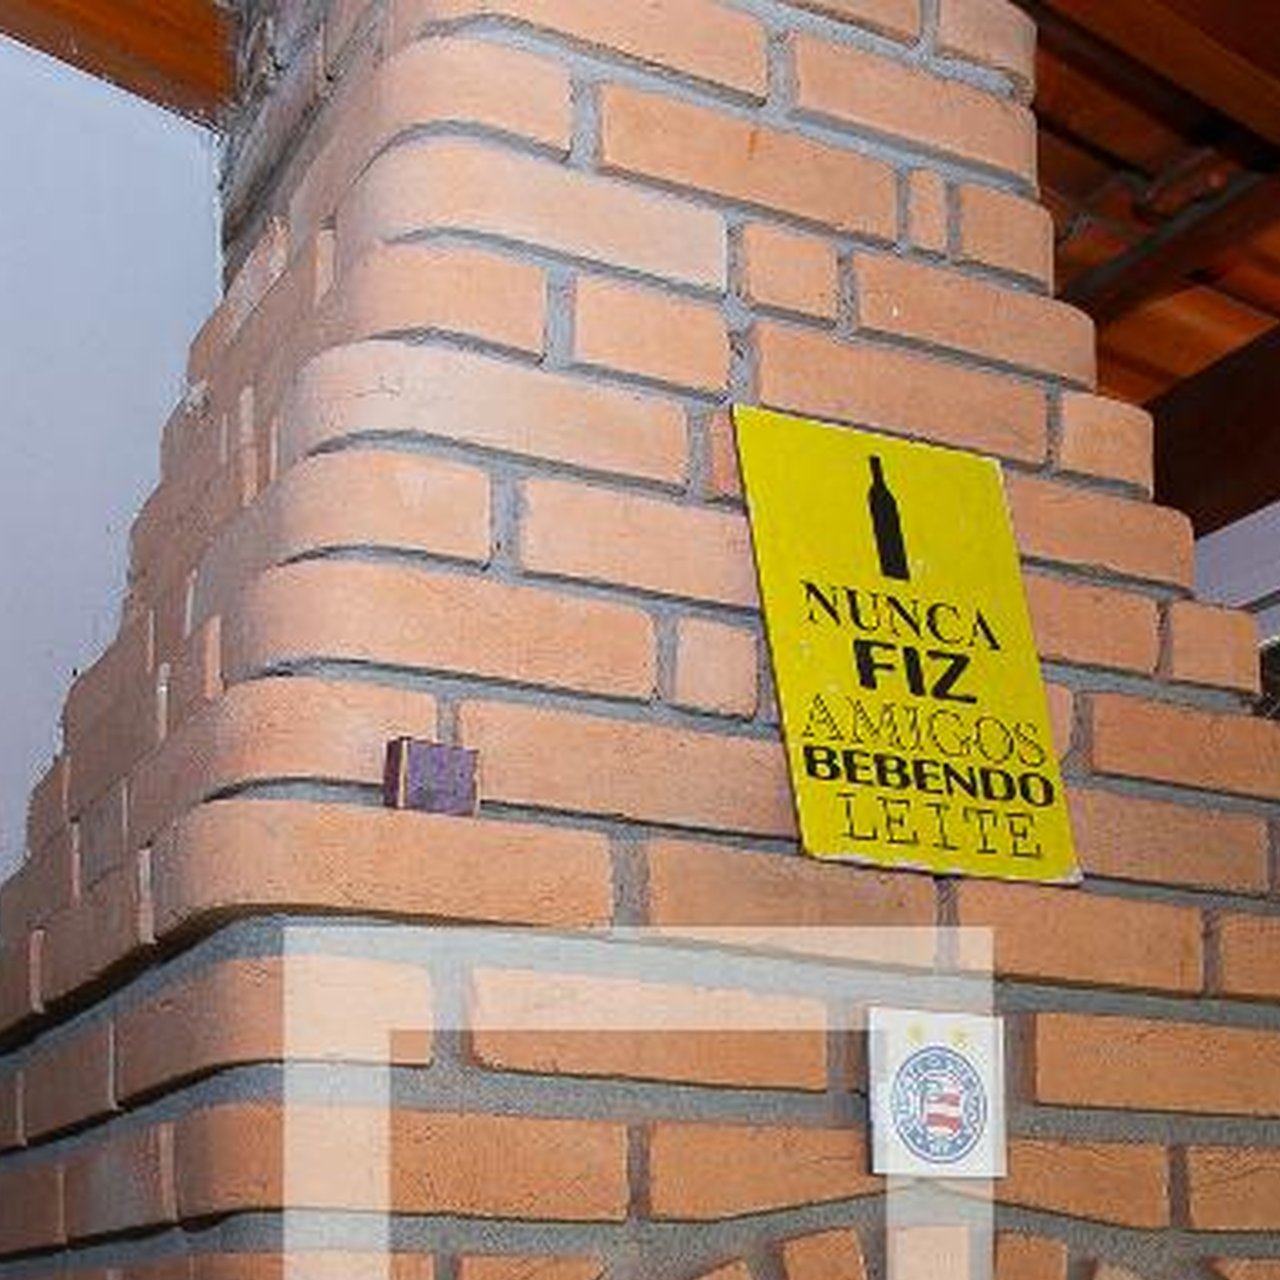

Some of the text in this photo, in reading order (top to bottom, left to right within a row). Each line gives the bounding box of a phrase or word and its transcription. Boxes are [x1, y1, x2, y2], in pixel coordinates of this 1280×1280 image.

[801, 580, 1001, 651] NUNCA
[853, 638, 977, 704] FIZ
[801, 693, 1046, 769] AMIGOS
[802, 743, 1056, 807] BEBENDO
[835, 792, 1043, 859] LEITE
